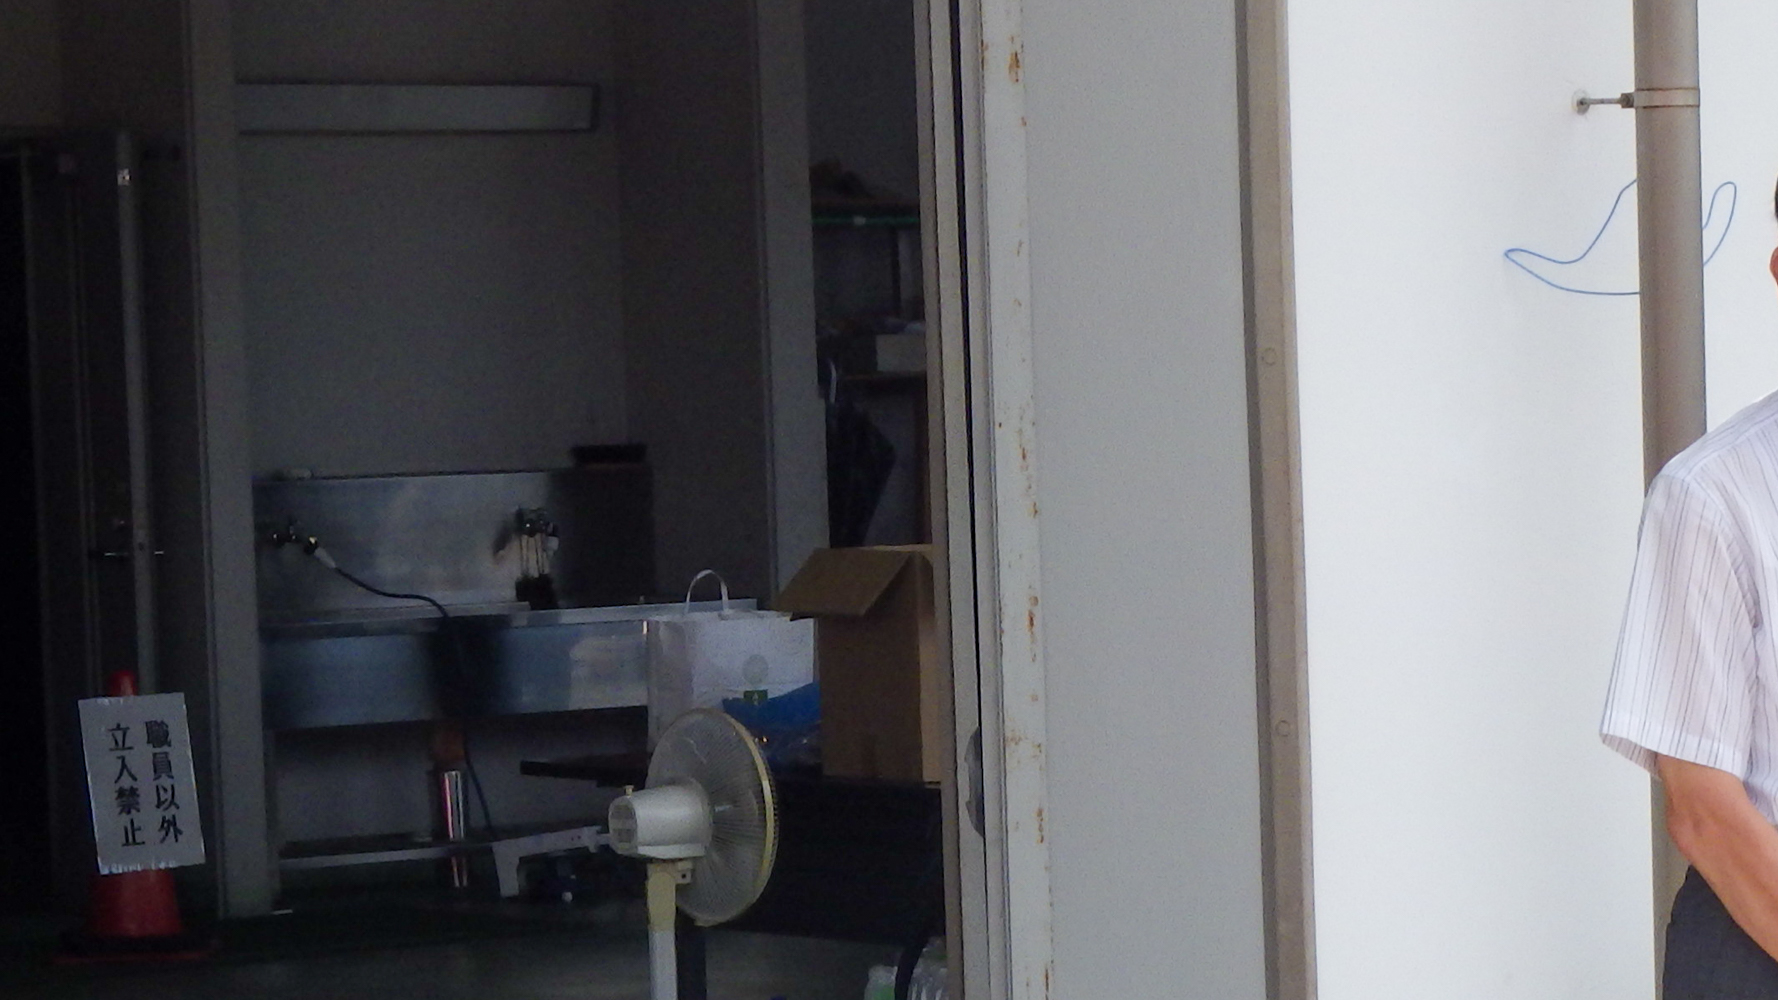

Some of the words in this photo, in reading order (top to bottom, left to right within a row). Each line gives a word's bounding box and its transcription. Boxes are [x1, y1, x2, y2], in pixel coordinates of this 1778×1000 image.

[108, 723, 145, 847] 立入禁止
[145, 720, 183, 844] 職員以外
